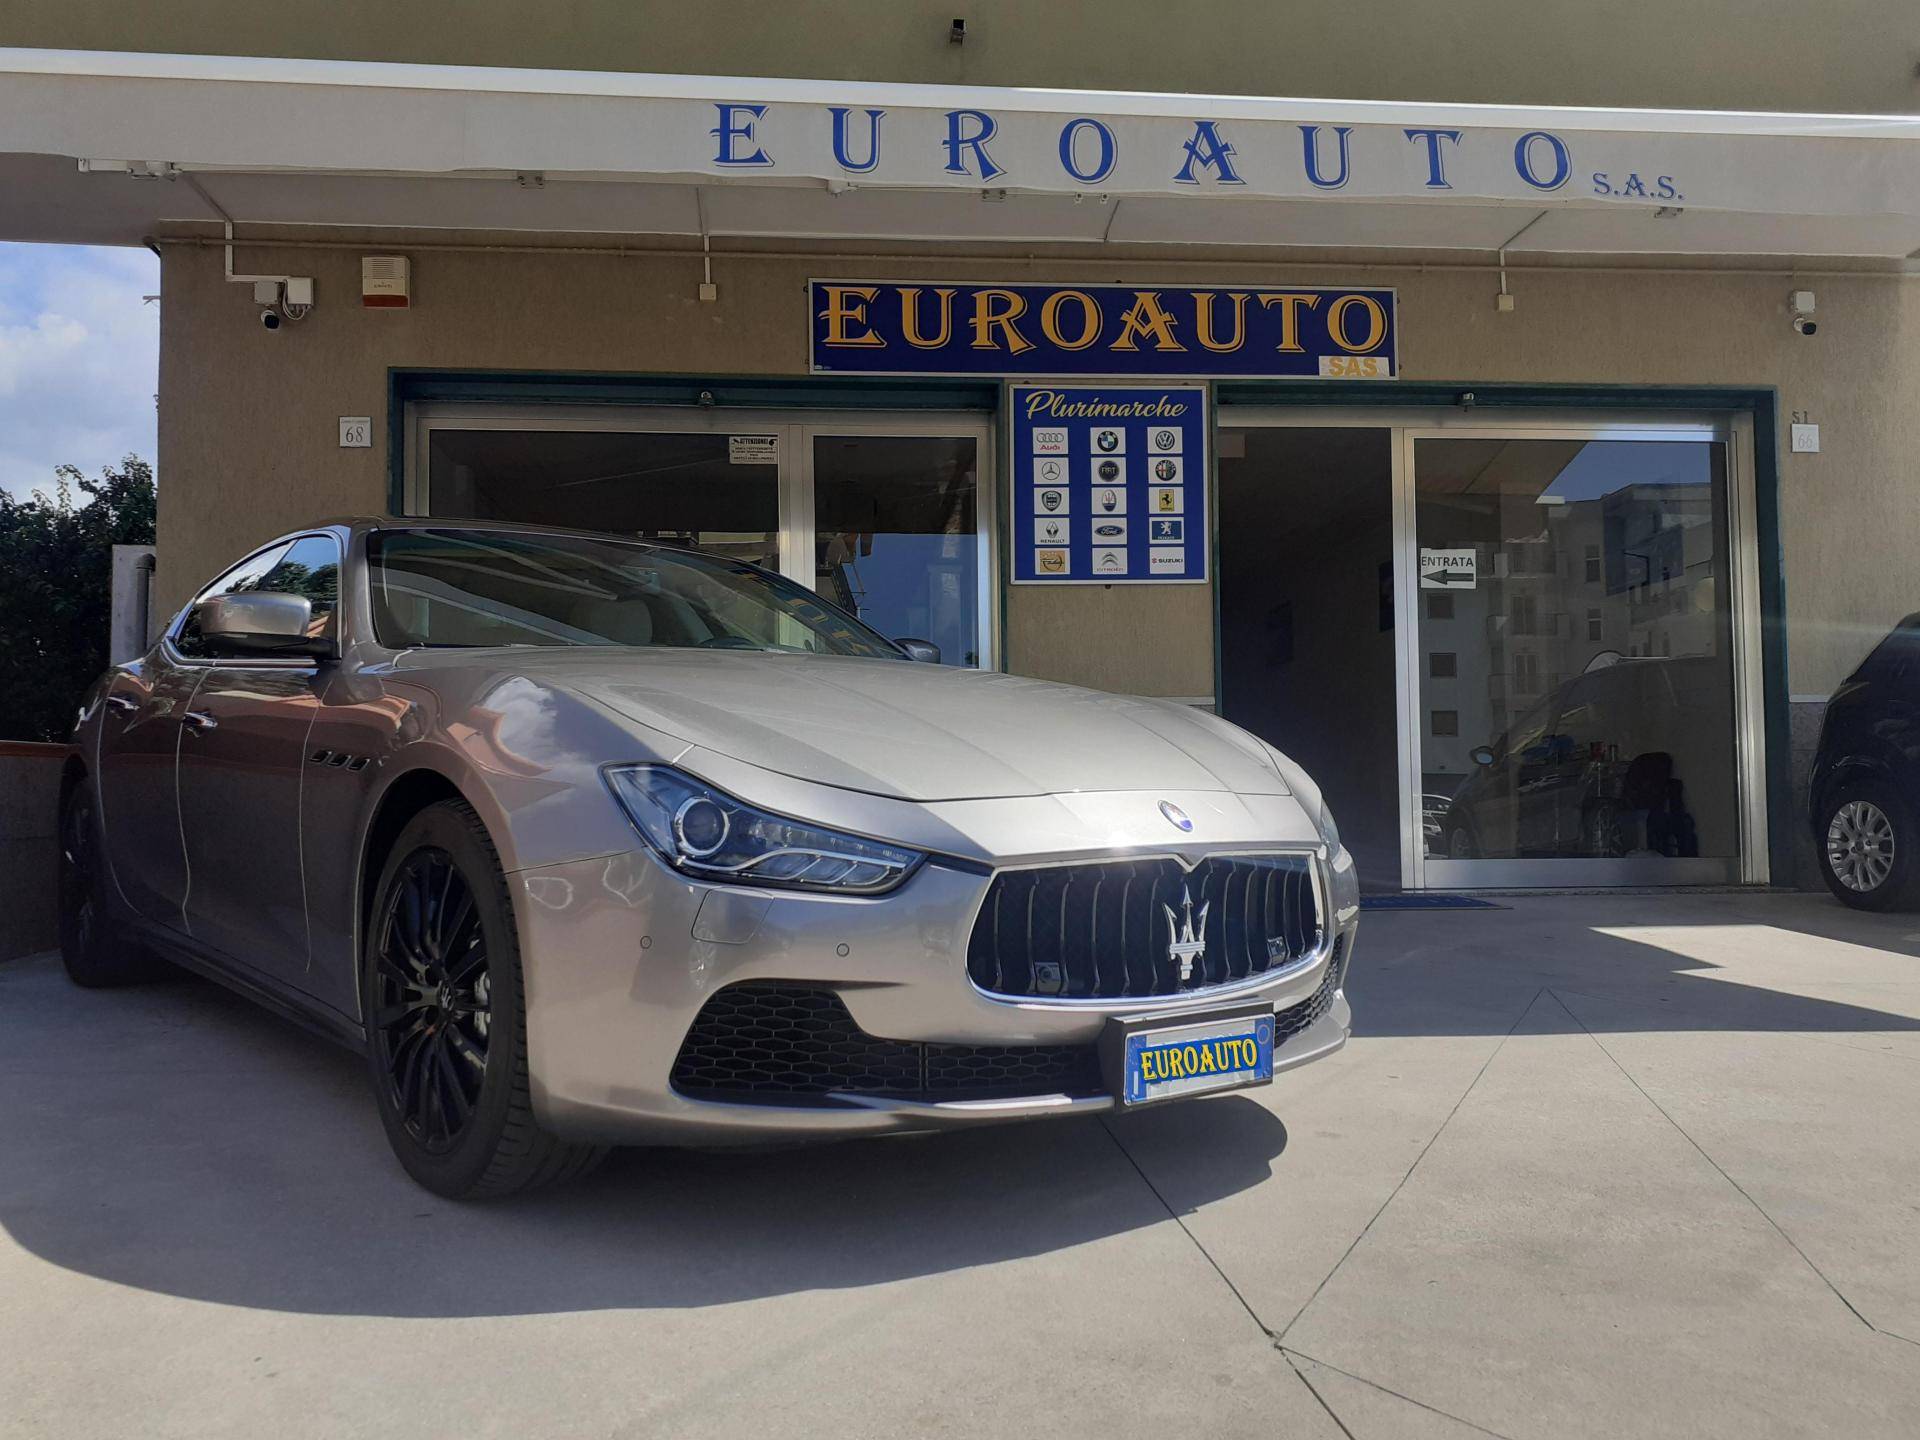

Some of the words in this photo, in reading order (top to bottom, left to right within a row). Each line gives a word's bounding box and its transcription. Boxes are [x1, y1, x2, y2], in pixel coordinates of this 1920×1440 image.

[709, 102, 1572, 192] EUROAUTO
[1592, 173, 1685, 200] S.A.S.
[818, 285, 1388, 355] EUROAUTO
[1328, 357, 1378, 377] SAS
[1025, 390, 1188, 420] Plurimarche
[345, 426, 364, 443] 68
[1421, 556, 1474, 567] ENTRATA
[1140, 1038, 1258, 1081] EUROAUTO
